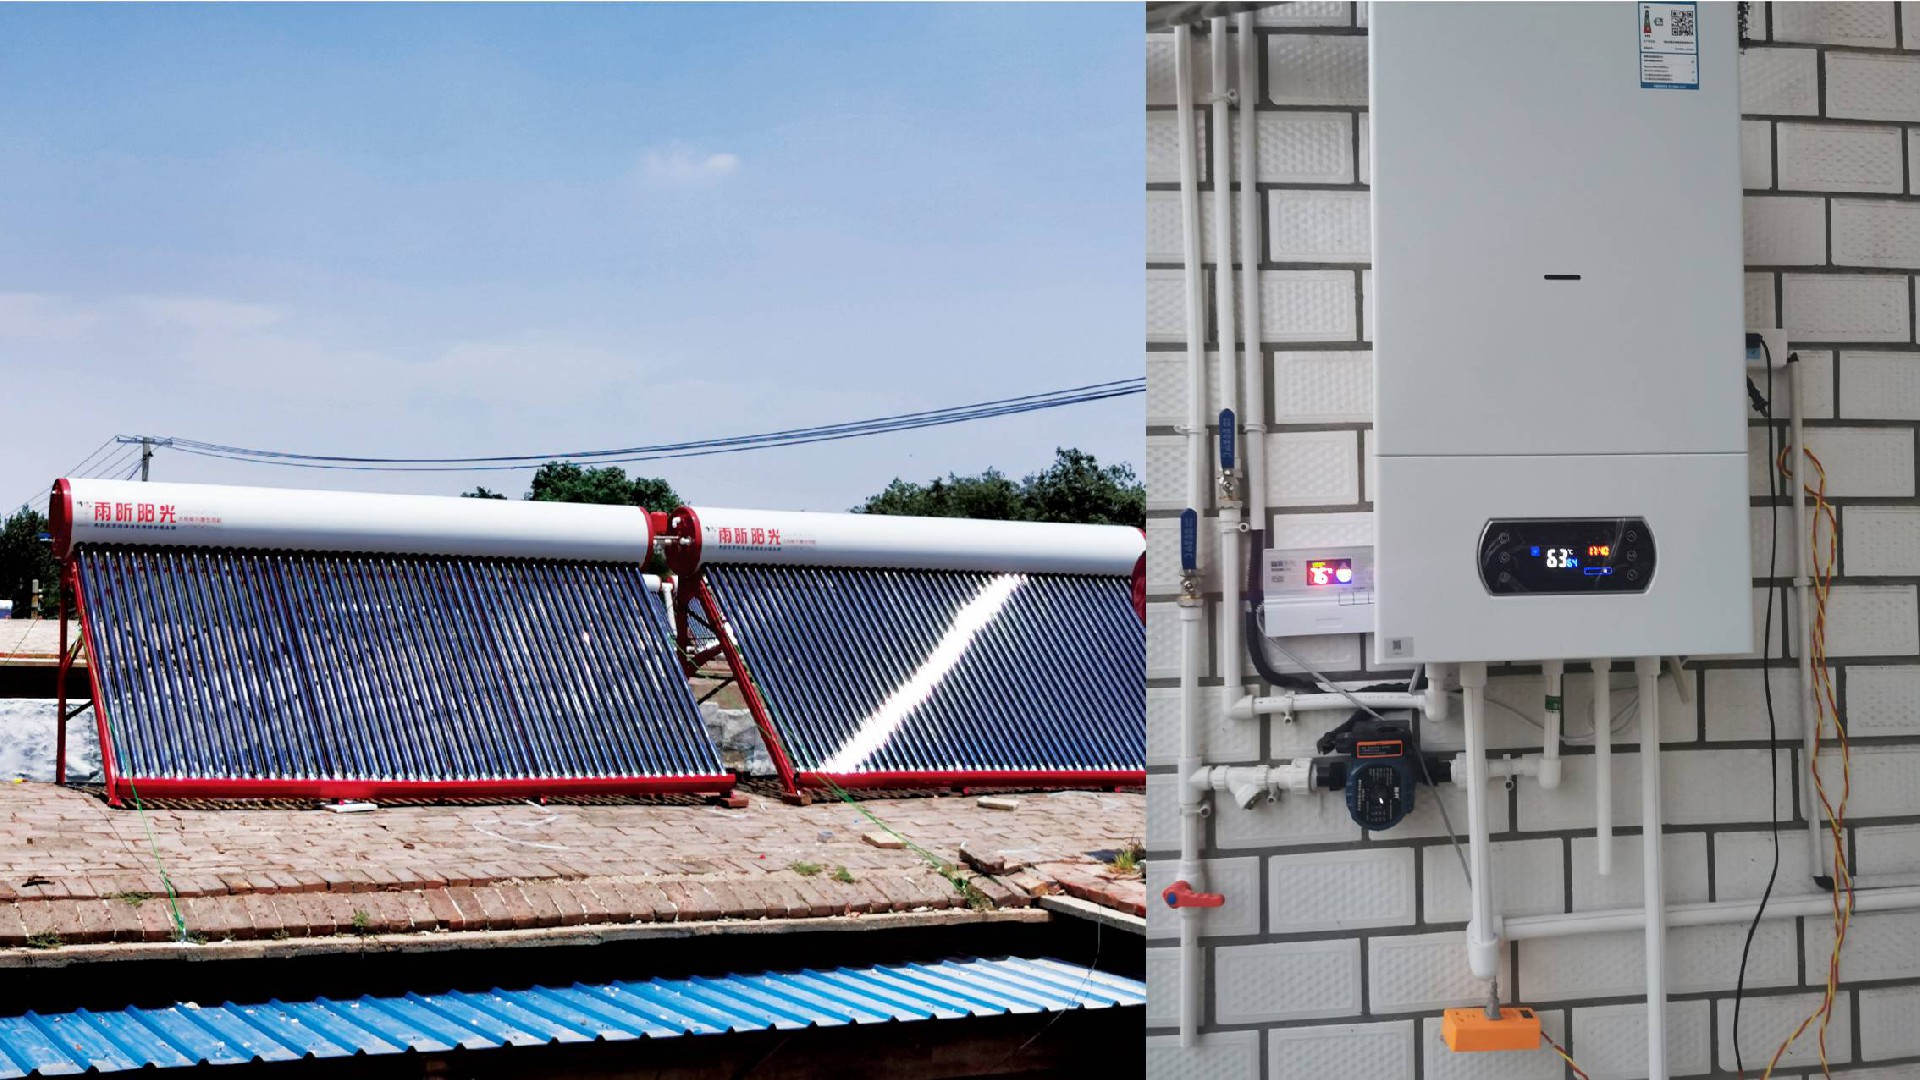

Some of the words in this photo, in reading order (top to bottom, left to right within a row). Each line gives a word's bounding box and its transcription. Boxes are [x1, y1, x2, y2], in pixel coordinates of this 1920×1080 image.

[94, 501, 176, 523] 雨昕阳光
[718, 527, 781, 545] 雨昕阳光
